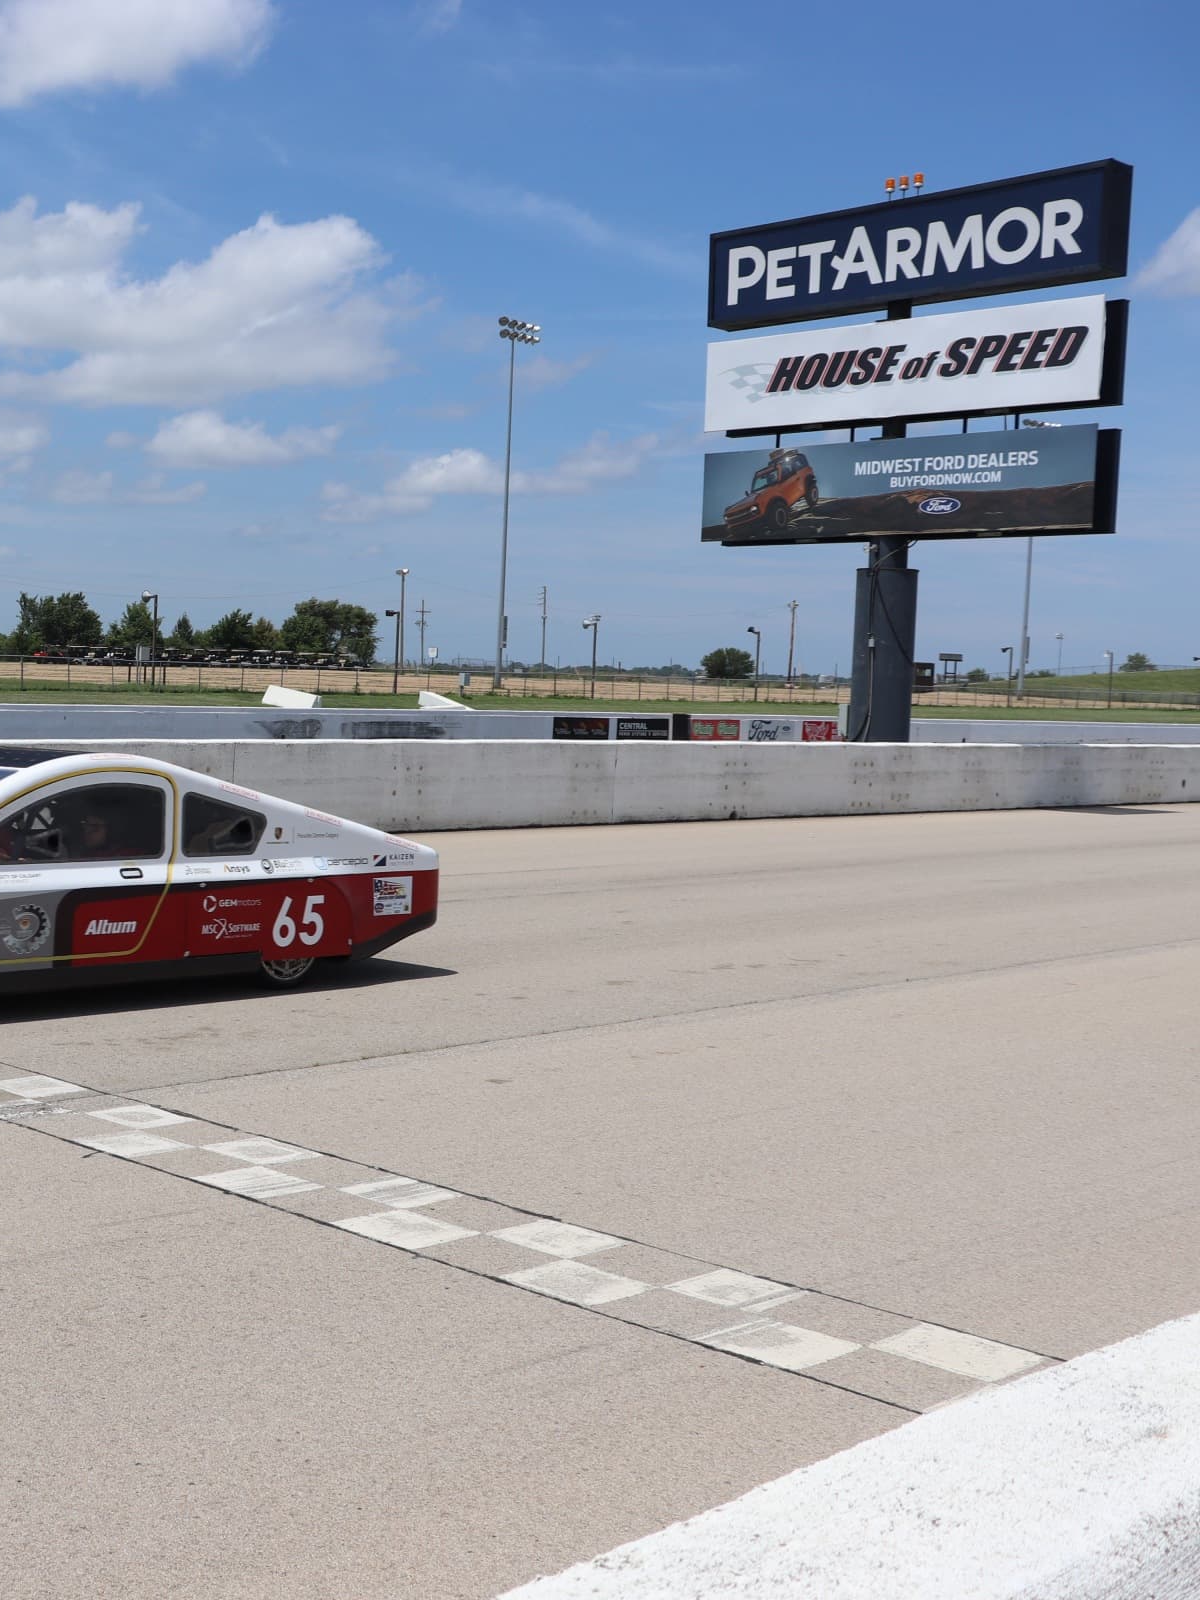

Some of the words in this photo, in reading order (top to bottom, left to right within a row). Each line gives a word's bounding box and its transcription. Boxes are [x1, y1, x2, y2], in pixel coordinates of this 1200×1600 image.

[727, 198, 1085, 306] PETARMOR
[765, 344, 907, 393] HOUSE
[898, 350, 941, 380] of
[937, 325, 1090, 378] SPEED
[854, 457, 922, 476] MIDWEST
[924, 454, 965, 472] FORD
[967, 450, 1039, 469] DEALERS
[889, 470, 1002, 488] BUYFORDNOW.COM
[924, 499, 956, 513] Ford
[619, 722, 648, 730] CENTRAL
[747, 719, 780, 741] Ford
[389, 853, 415, 861] KAIZEN
[223, 863, 250, 874] Ansys
[272, 894, 325, 948] 65
